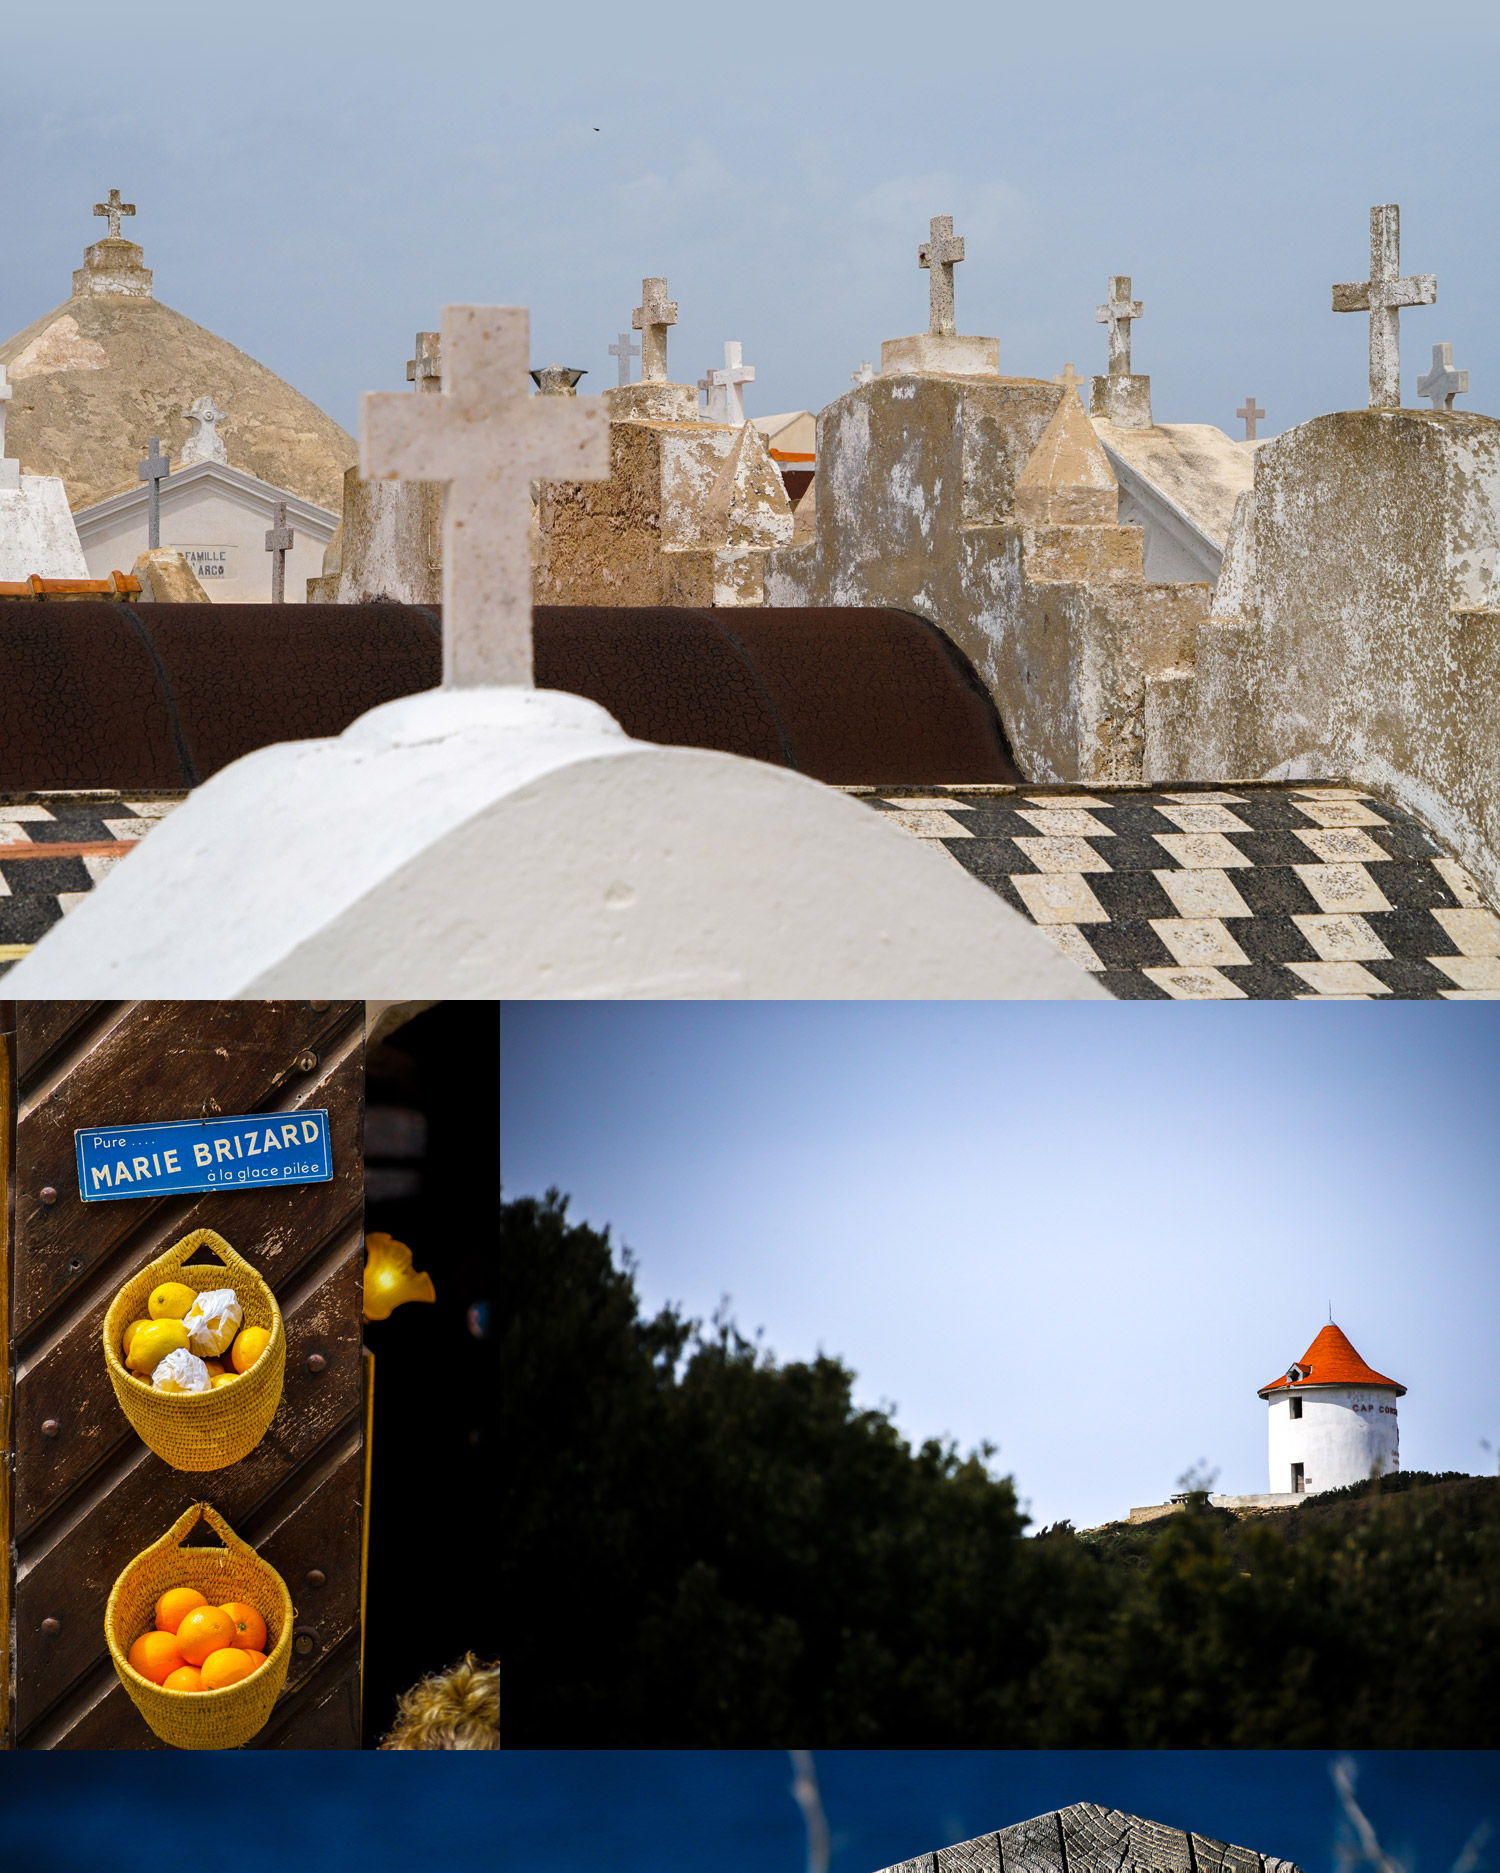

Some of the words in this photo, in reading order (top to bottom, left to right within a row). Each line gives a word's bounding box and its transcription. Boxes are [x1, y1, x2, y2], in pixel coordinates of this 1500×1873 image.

[185, 551, 226, 561] FAMILLE
[189, 562, 225, 576] 'ARCO
[93, 1137, 127, 1149] Pure
[91, 1149, 182, 1190] MARIE
[192, 1120, 319, 1167] BRIZARD
[207, 1170, 216, 1182] à
[219, 1168, 233, 1181] la
[238, 1166, 279, 1182] glace
[283, 1161, 320, 1178] pilée
[1352, 1404, 1374, 1413] CAP
